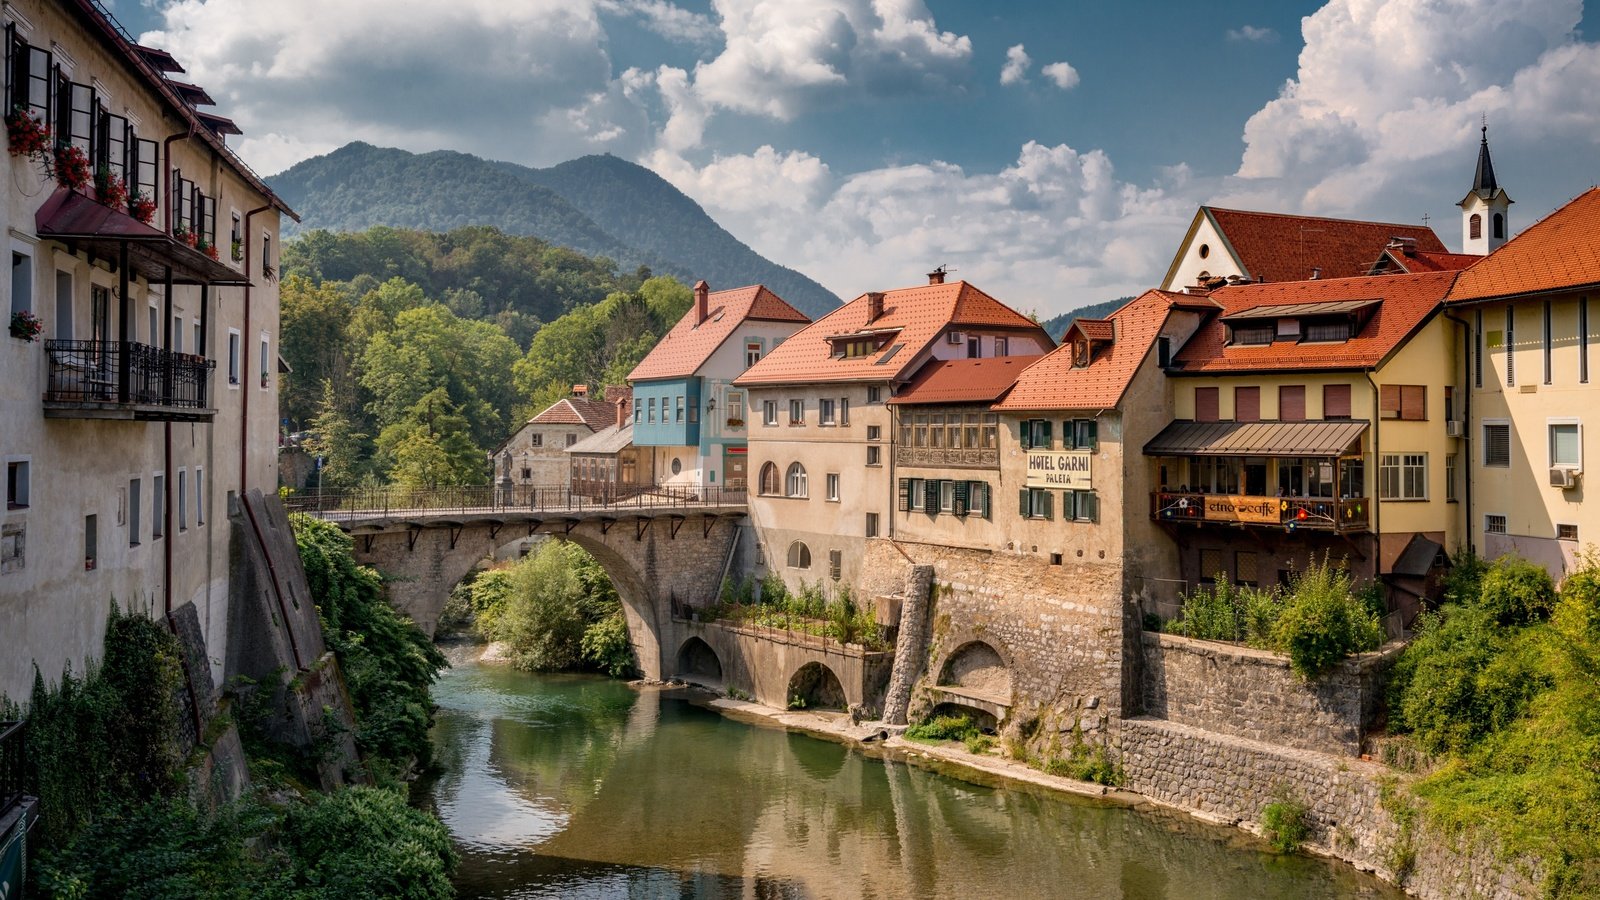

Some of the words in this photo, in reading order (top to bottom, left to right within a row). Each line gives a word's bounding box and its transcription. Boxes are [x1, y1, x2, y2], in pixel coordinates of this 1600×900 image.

[1029, 455, 1055, 470] HOTEL
[1058, 456, 1088, 471] GARNI
[1209, 502, 1235, 512] etno
[1247, 502, 1275, 517] caffe
